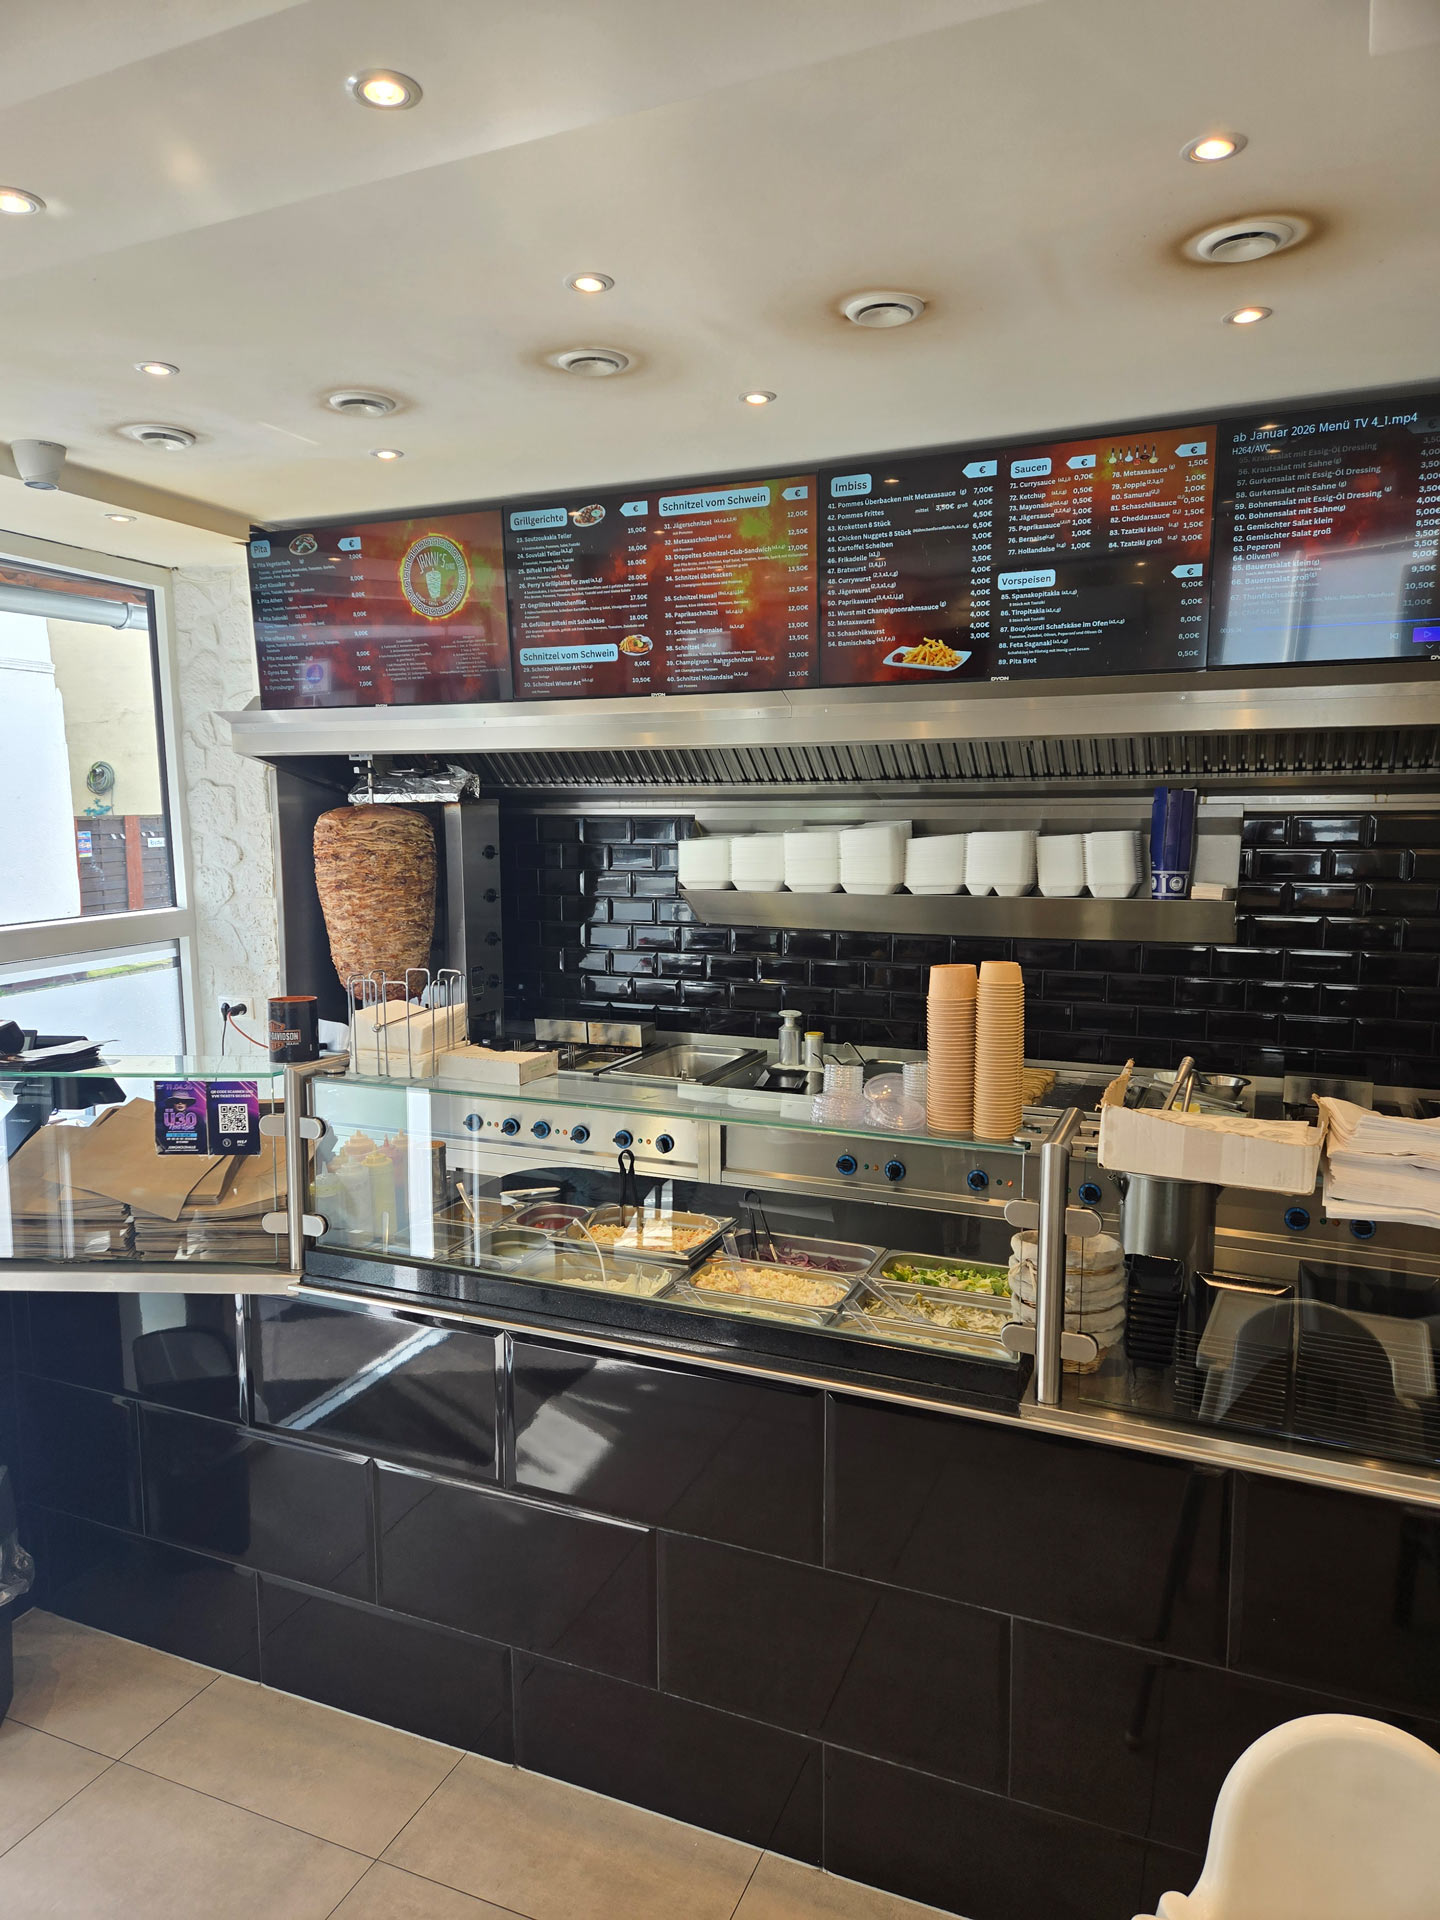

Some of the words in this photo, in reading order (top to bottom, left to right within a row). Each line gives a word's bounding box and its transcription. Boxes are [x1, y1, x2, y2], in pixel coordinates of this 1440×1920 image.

[1233, 429, 1247, 443] ab
[1250, 427, 1288, 441] Januar
[1290, 425, 1316, 436] 2026
[1319, 419, 1350, 433] Menü
[1354, 418, 1369, 428] TV
[1190, 446, 1198, 455] €
[1232, 444, 1271, 456] H264/AVC
[1081, 458, 1089, 468] €
[1188, 458, 1208, 467] 1,50€
[979, 466, 986, 474] €
[1014, 463, 1048, 474] Saucen
[1123, 468, 1168, 476] Metaxasauce
[1252, 464, 1292, 473] Krautsalat
[1074, 473, 1094, 482] 0,70€
[1185, 474, 1206, 482] 1,00€
[1249, 475, 1296, 484] Gurkensalat
[1312, 469, 1344, 478] Essig-Öl
[1346, 467, 1381, 476] Dressing
[835, 480, 867, 492] Imbiss
[973, 486, 993, 494] 7,00€
[1072, 486, 1094, 495] 0,50€
[1249, 488, 1295, 497] Gurkensalat
[662, 499, 704, 512] Schnitzel
[706, 498, 725, 507] vom
[727, 492, 766, 505] Schwein
[972, 498, 993, 507] 4,00€
[1071, 495, 1092, 505] 0,50€
[1248, 499, 1297, 508] Bohnensalat
[1313, 493, 1345, 502] Essig-Öl
[1346, 491, 1382, 499] Dressing
[1121, 501, 1177, 510] Schaschliksauce
[972, 510, 992, 519] 4,50€
[1072, 507, 1092, 516] 1,00€
[1248, 510, 1297, 519] Bohnensalat
[513, 514, 564, 526] Grillgerichte
[1072, 518, 1092, 526] 1,00€
[1121, 514, 1170, 522] Cheddarsauce
[972, 521, 992, 529] 6,50€
[1246, 522, 1291, 530] Gemischter
[1071, 529, 1091, 537] 1,00€
[1246, 533, 1290, 541] Gemischter
[1312, 528, 1331, 536] groß
[349, 539, 354, 548] €
[1071, 542, 1091, 550] 1,00€
[1146, 538, 1162, 546] groß
[253, 545, 268, 553] Pita
[1246, 543, 1281, 551] Peperoni
[1002, 574, 1052, 586] Vorspeisen
[867, 605, 939, 614] Champignonrahmsauce
[523, 651, 560, 661] Schnitzel
[581, 649, 614, 658] Schwein
[164, 1108, 197, 1128] Ü30
